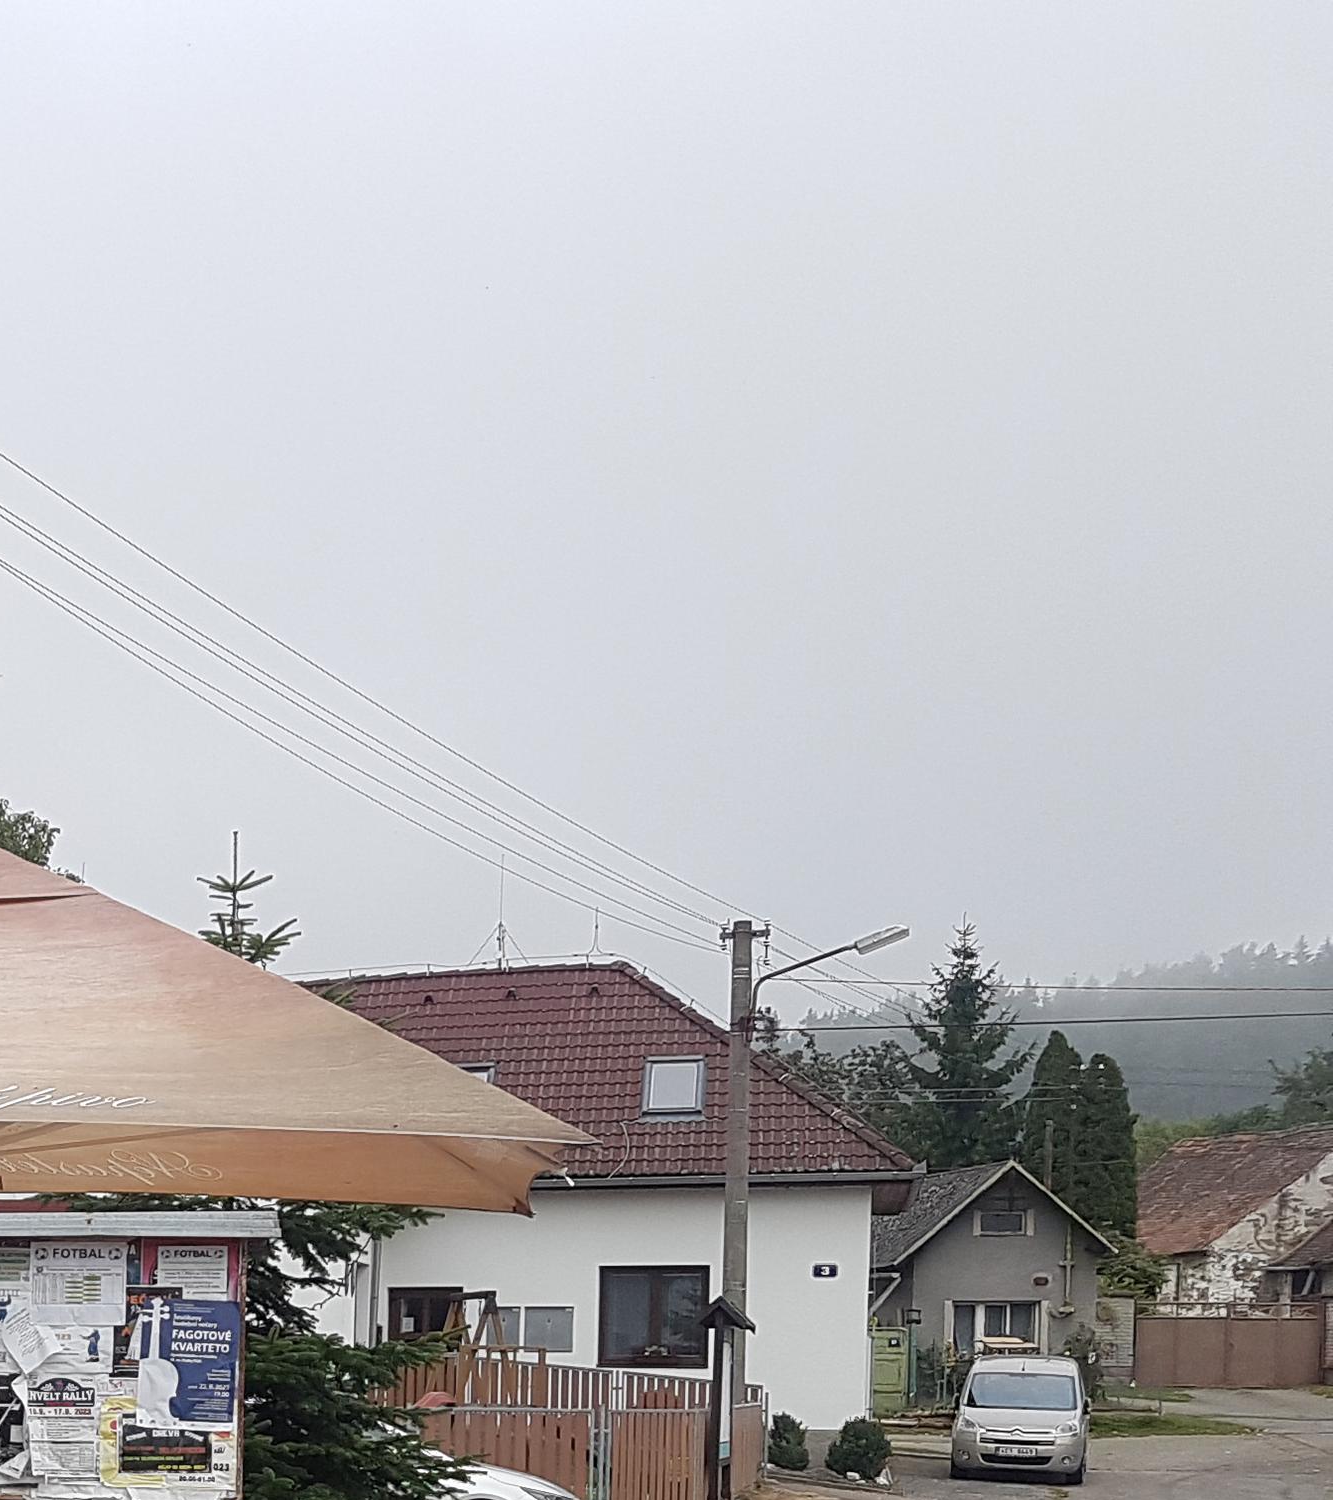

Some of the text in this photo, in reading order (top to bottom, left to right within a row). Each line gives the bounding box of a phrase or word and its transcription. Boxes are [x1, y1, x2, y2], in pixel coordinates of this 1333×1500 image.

[52, 1248, 105, 1259] FOTBAL
[174, 1250, 212, 1259] FOTBAL
[172, 1328, 232, 1342] FAGOTOVÉ
[170, 1341, 230, 1353] KVARTETO
[62, 1390, 94, 1401] RALLY
